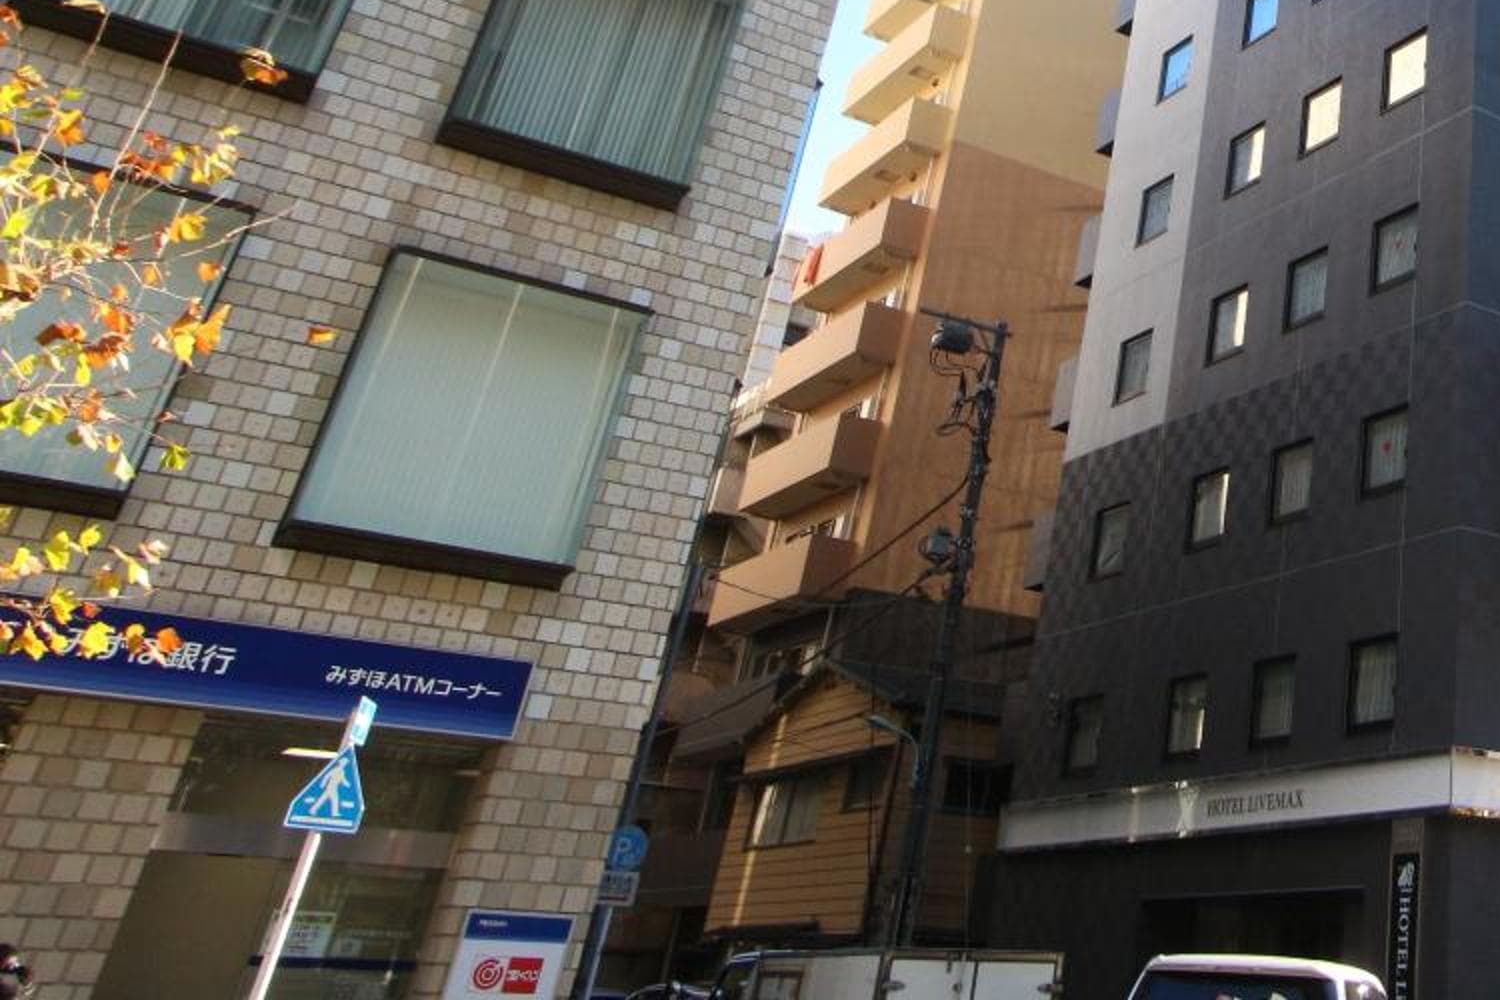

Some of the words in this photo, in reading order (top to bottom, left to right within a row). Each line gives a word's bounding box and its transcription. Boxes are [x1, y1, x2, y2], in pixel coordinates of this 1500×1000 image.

[325, 665, 502, 699] みずほATMコーナー
[1207, 797, 1245, 817] HOTEL
[1397, 897, 1410, 975] HOTEL
